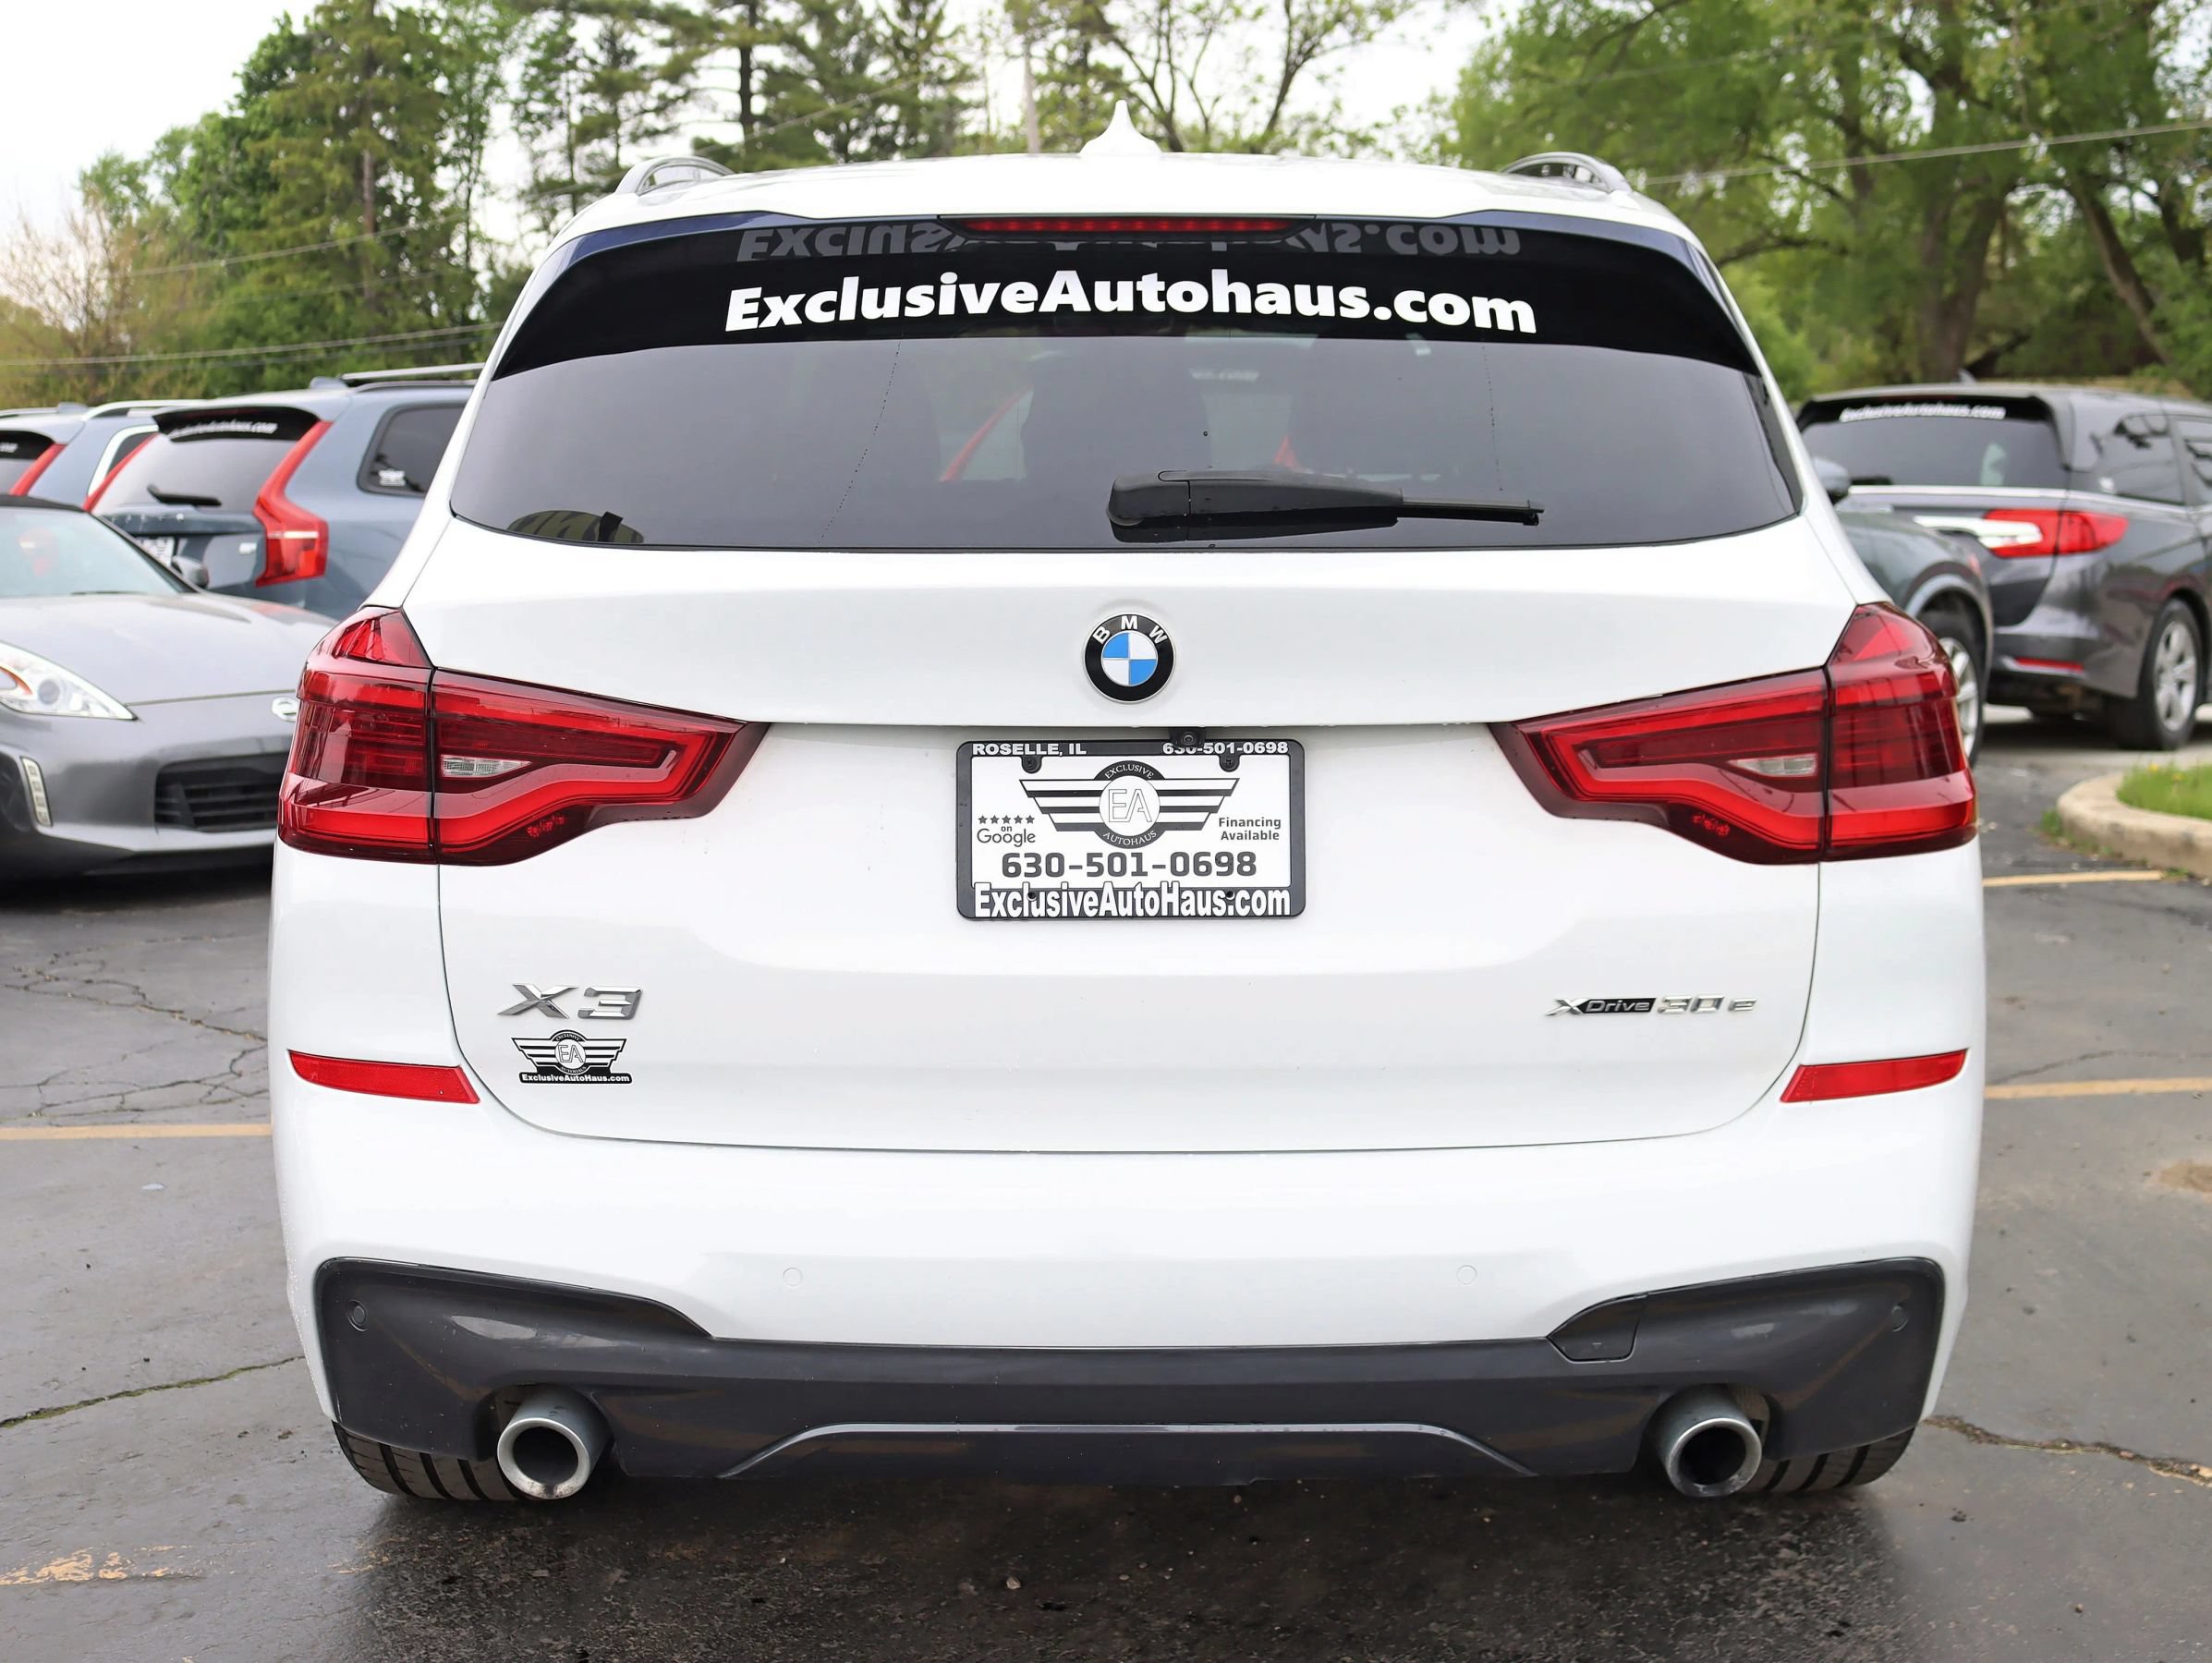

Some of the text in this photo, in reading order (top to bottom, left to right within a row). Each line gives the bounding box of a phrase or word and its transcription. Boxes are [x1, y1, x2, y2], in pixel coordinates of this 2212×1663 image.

[725, 269, 1537, 334] ExclusiveAutohaus.com
[1092, 615, 1168, 645] BMW
[972, 743, 1088, 756] ROSELLE, IL
[1104, 763, 1154, 779] EXCLUSIVE
[1109, 789, 1152, 822] EA
[1219, 817, 1282, 829] Financing
[977, 829, 1036, 847] Google
[1103, 830, 1157, 845] AUTOHAUS
[1221, 831, 1280, 840] Available
[1003, 852, 1257, 878] 630-501-0698
[975, 881, 1291, 917] ExclusiveAutoHaus.com
[497, 983, 644, 1020] X3
[557, 1044, 584, 1062] EA
[522, 1074, 630, 1082] ExclusiveAutoHaus.com
